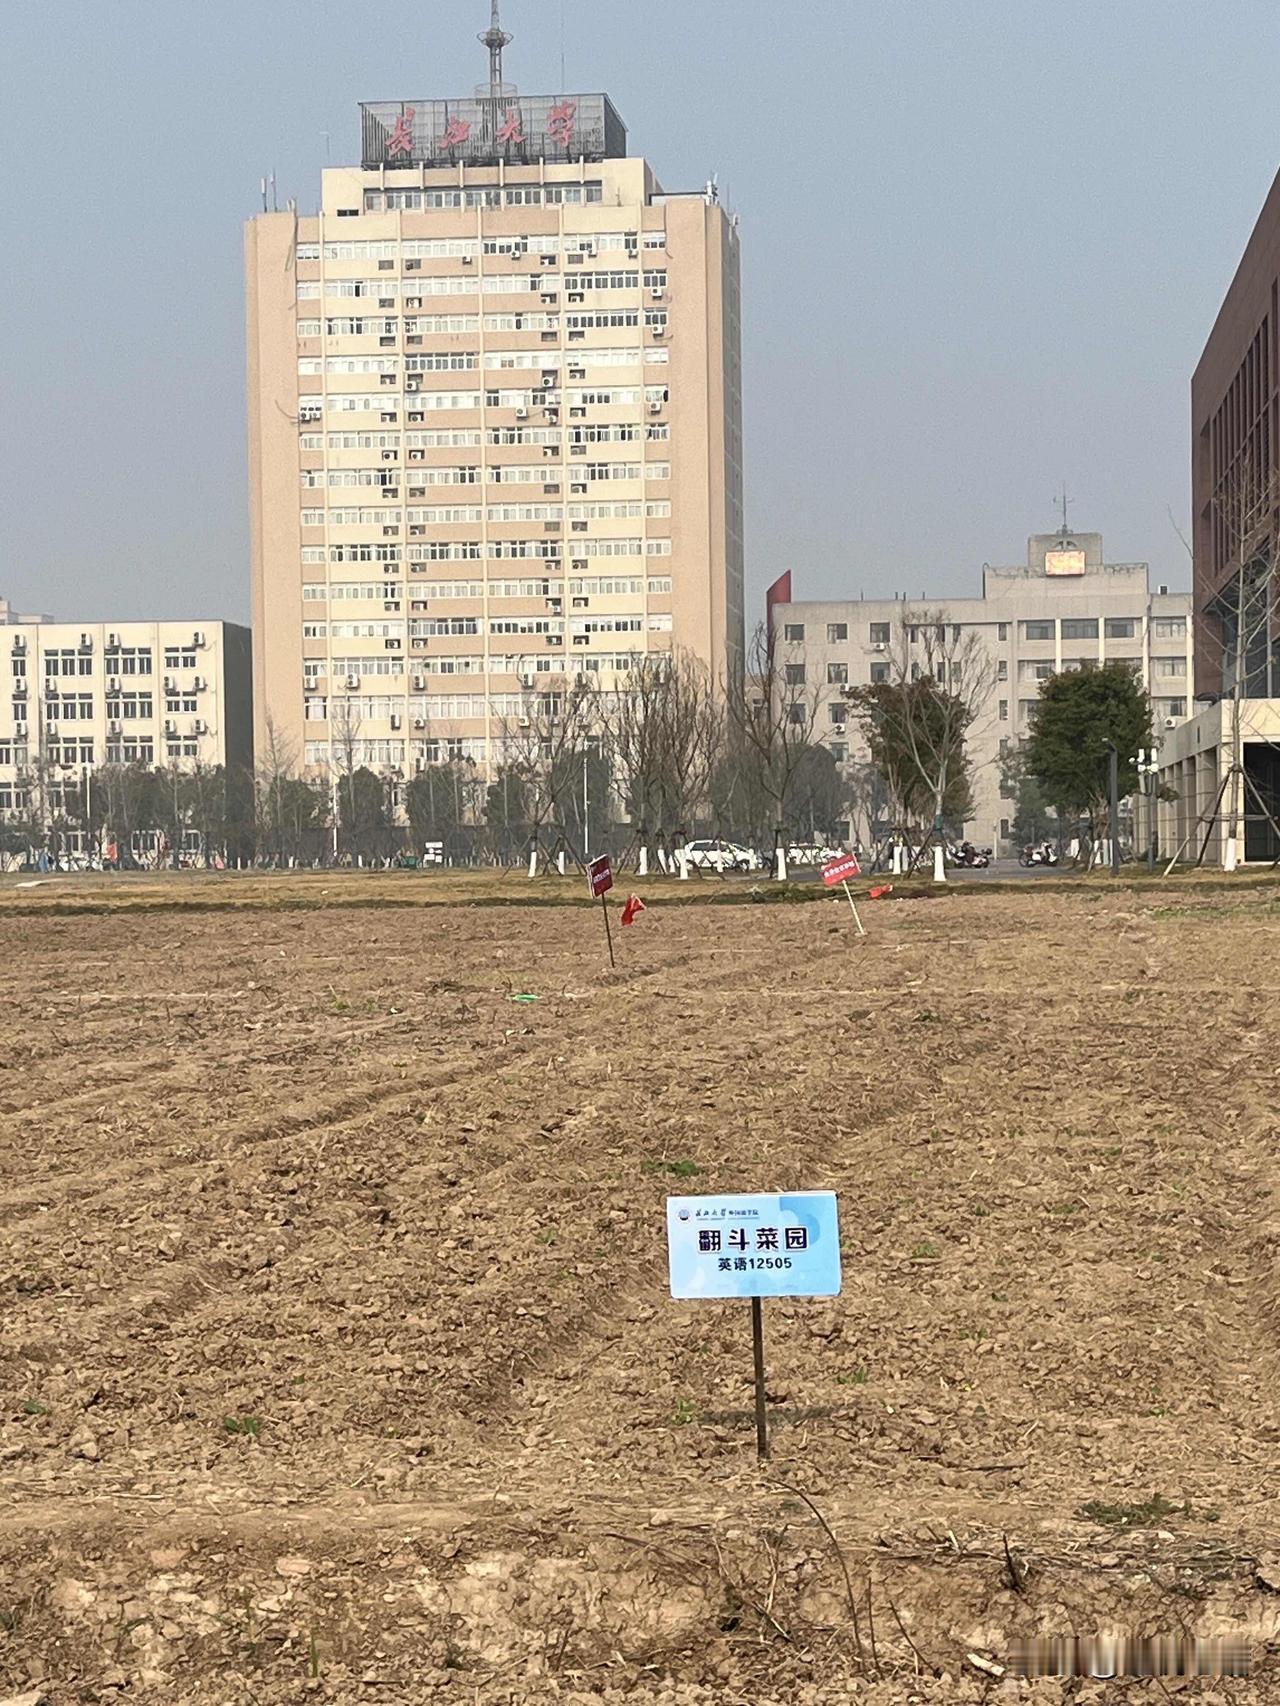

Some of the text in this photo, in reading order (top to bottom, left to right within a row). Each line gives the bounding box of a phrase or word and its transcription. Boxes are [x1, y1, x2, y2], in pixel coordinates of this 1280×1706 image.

[698, 1227, 808, 1251] 翻斗菜园
[718, 1257, 793, 1272] 英语12505
